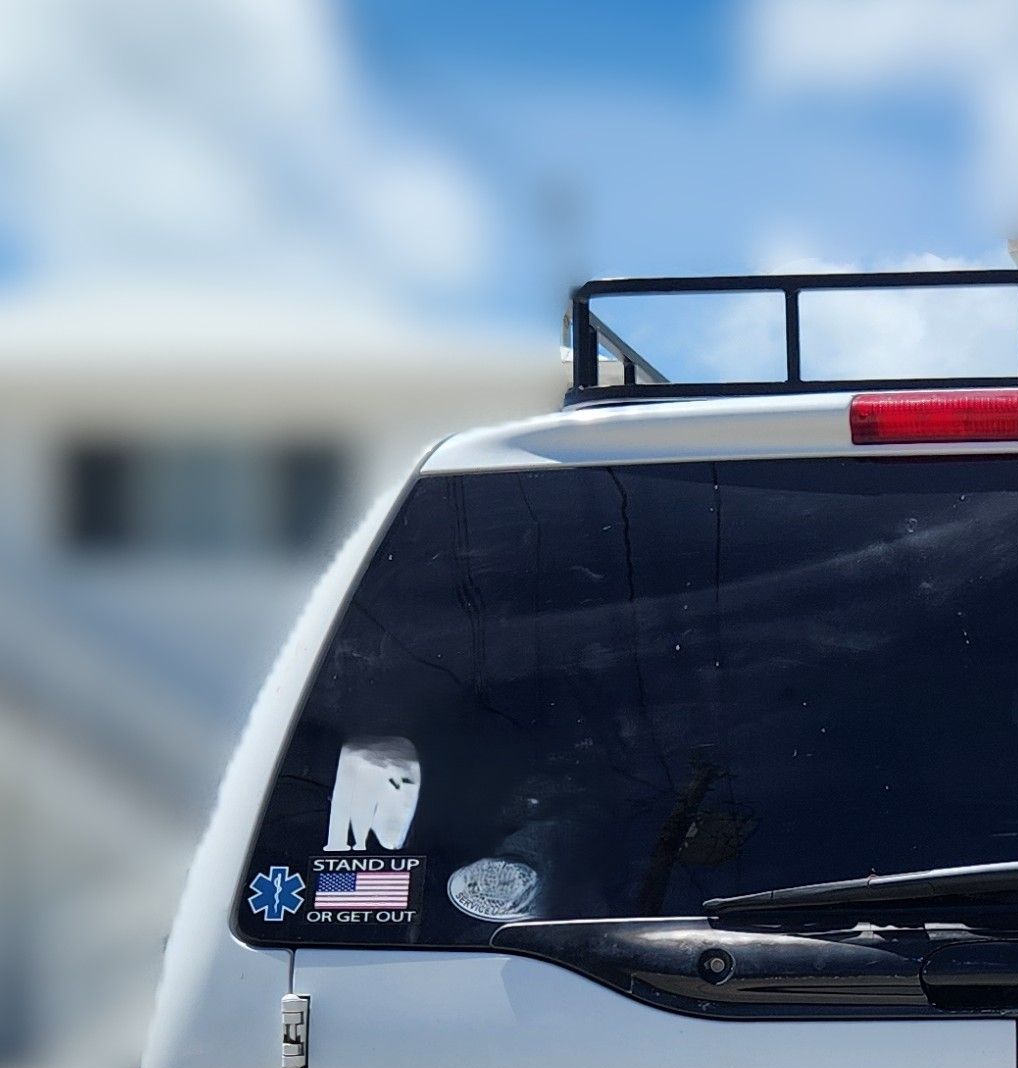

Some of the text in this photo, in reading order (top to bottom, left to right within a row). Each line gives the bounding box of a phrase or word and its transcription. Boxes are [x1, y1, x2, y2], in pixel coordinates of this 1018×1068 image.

[313, 858, 420, 871] STAND UP
[306, 911, 417, 922] OR GET OUT
